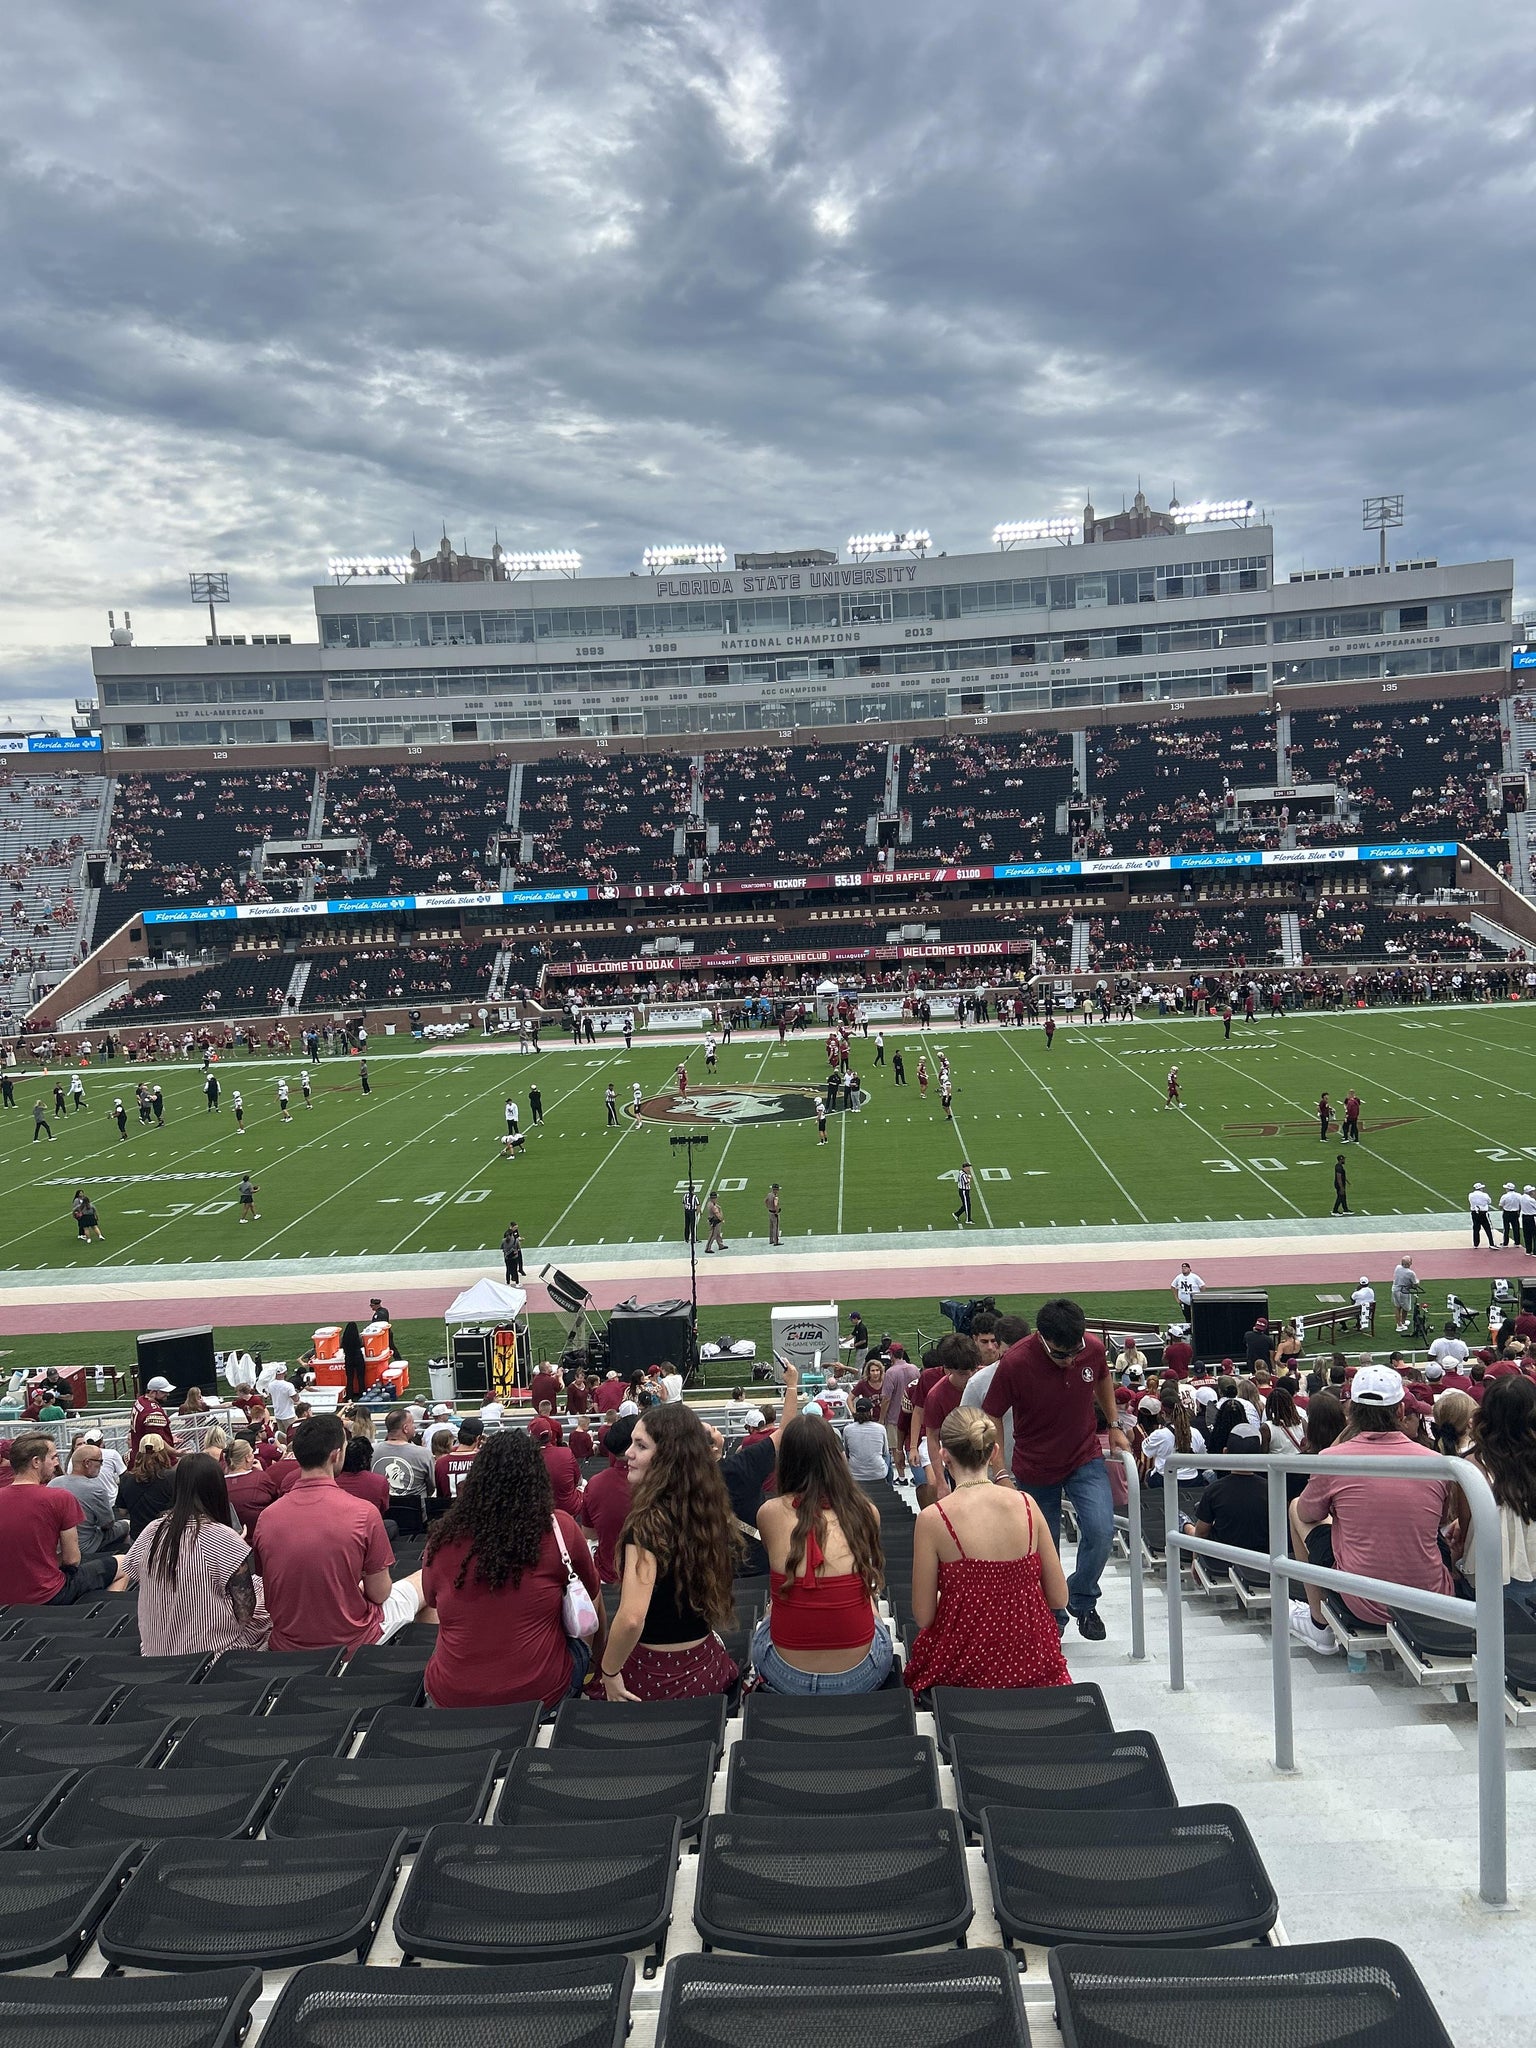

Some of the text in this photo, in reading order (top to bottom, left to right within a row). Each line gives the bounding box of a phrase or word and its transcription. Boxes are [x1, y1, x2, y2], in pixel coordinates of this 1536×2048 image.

[657, 566, 917, 597] FLORIDA STATE UNIVERSITY
[904, 628, 933, 638] 2013
[721, 632, 861, 650] NATIONAL CHAMPIONS
[1346, 642, 1371, 651] BOWL
[1374, 636, 1441, 649] APPEARANCES
[575, 646, 605, 656] 1993
[648, 642, 678, 653] 1999
[779, 686, 827, 695] CHAMPIONS
[1382, 684, 1398, 692] 135
[1170, 703, 1185, 711] 134
[194, 709, 264, 717] ALL-AMERICANS
[778, 730, 792, 738] 132
[33, 740, 80, 749] Florida Blue
[212, 752, 228, 760] 129
[407, 747, 422, 755] 130
[0, 758, 7, 766] 8
[1273, 851, 1327, 862] Florida Blue
[1369, 846, 1425, 858] Florida Blue
[1092, 861, 1143, 871] Florida Blue
[1181, 855, 1232, 866] Florida Blue
[957, 869, 981, 880] $1100
[1004, 865, 1054, 876] Florida Blue
[835, 874, 862, 887] 55:18
[872, 872, 931, 883] 50/50 RAFFLE
[703, 882, 710, 894] 0
[773, 878, 807, 889] KICKOFF
[513, 891, 561, 902] Florida Blue
[635, 886, 642, 897] 0
[338, 900, 388, 910] Florida Blue
[425, 896, 475, 906] Florida Blue
[156, 910, 208, 921] Florida Blue
[248, 906, 300, 916] Florida Blue
[903, 943, 1003, 957] WELCOME TO DOAK
[707, 958, 738, 966] RELIAQUEST
[748, 952, 828, 963] WEST SIDELINE CLUB
[576, 959, 674, 974] WELCOME TO DOAK
[1201, 1157, 1288, 1173] 30
[936, 1167, 1012, 1182] 40
[673, 1178, 748, 1194] 50
[412, 1189, 493, 1205] 40
[148, 1201, 239, 1218] 30
[1181, 1281, 1193, 1292] NM
[446, 1473, 468, 1498] 1
